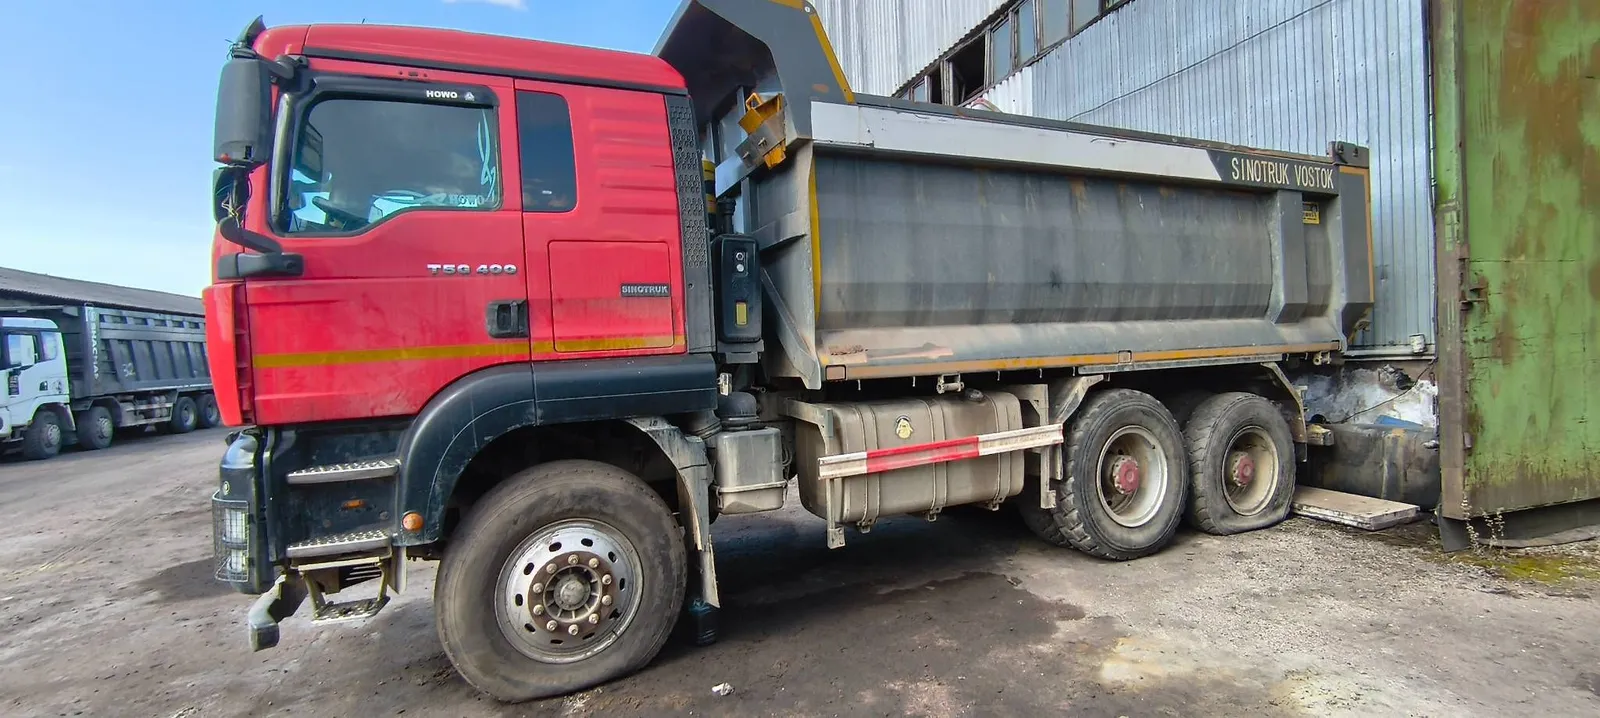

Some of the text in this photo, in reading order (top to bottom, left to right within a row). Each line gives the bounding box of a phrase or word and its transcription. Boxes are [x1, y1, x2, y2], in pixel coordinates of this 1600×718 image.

[426, 90, 458, 99] HOWO
[1231, 157, 1334, 190] SINOTRUK VOSTOK
[449, 194, 485, 205] HOWO
[476, 264, 517, 275] 400
[622, 285, 668, 294] SINOTRUK
